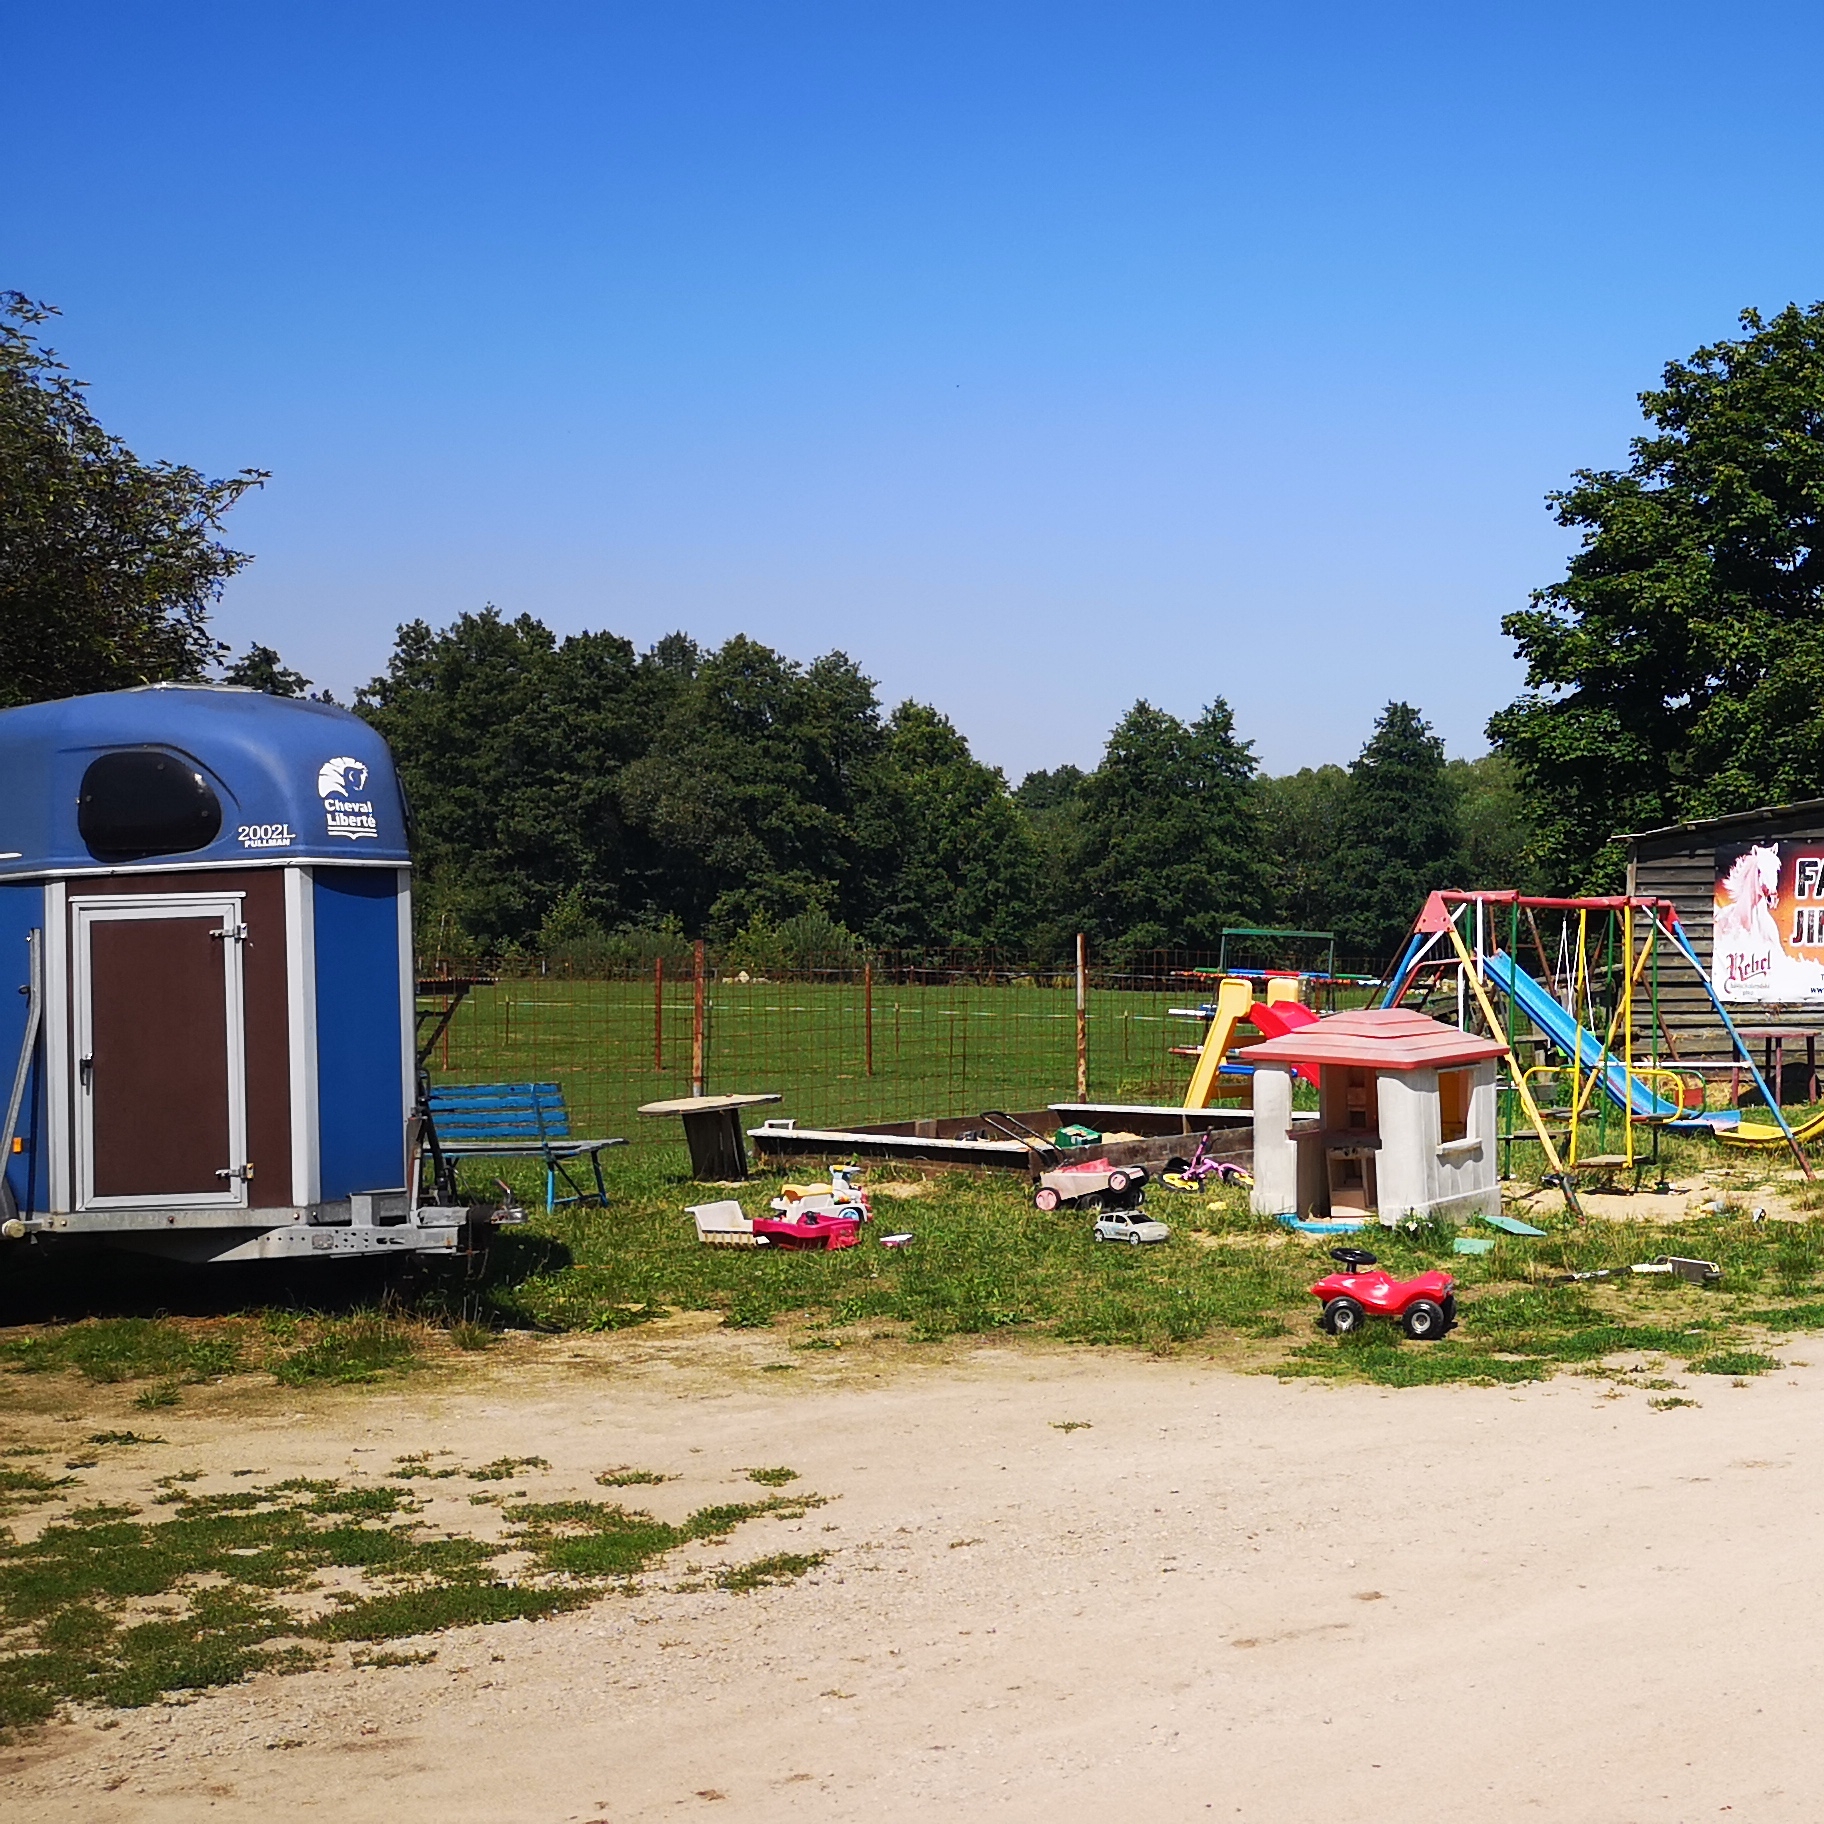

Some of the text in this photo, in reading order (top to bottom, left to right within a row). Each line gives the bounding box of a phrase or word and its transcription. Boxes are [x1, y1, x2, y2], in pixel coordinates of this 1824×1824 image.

[324, 799, 373, 813] Cheval
[326, 812, 377, 828] Liberté
[237, 824, 297, 841] 2002L
[244, 839, 291, 848] PULLMAN
[1725, 949, 1771, 982] Rebel
